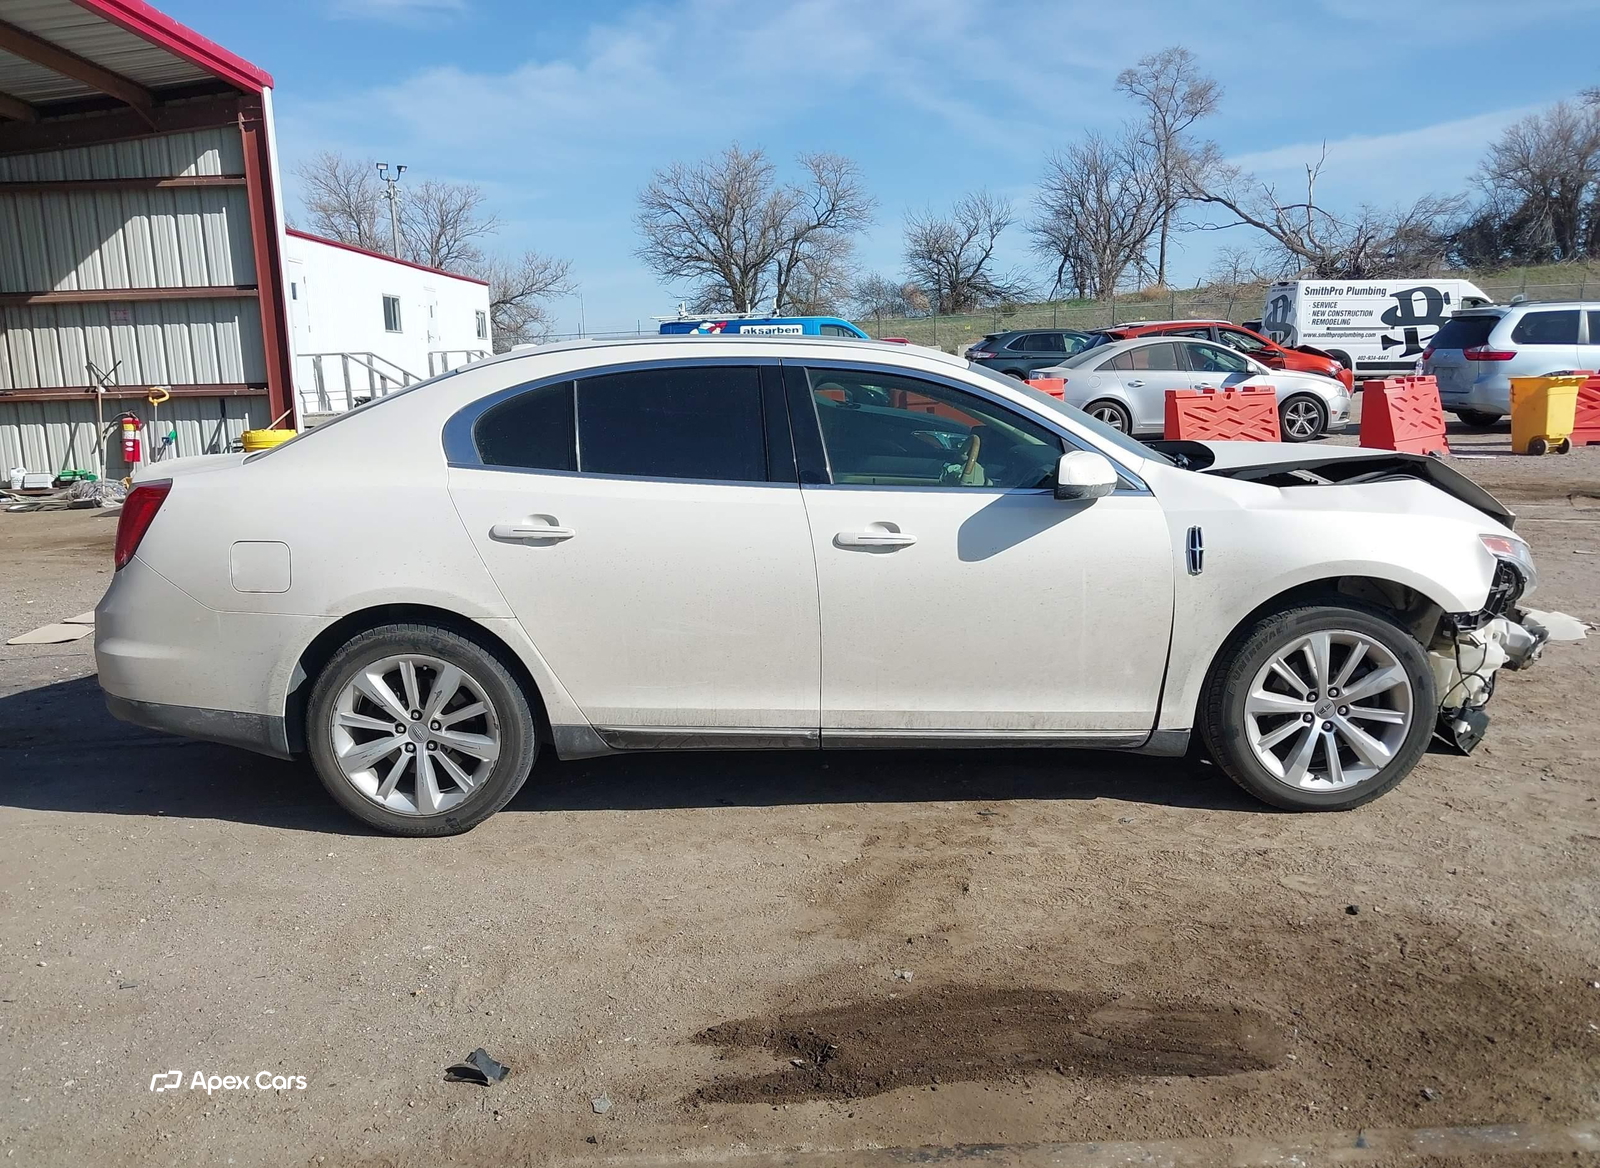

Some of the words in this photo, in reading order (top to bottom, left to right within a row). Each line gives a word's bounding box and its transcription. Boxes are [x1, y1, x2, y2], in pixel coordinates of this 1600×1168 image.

[1304, 286, 1344, 296] SmithPro
[1346, 286, 1387, 297] Plumbing
[1312, 301, 1338, 309] SERVICE
[1311, 318, 1351, 326] REMODELING
[743, 327, 799, 335] aksarben
